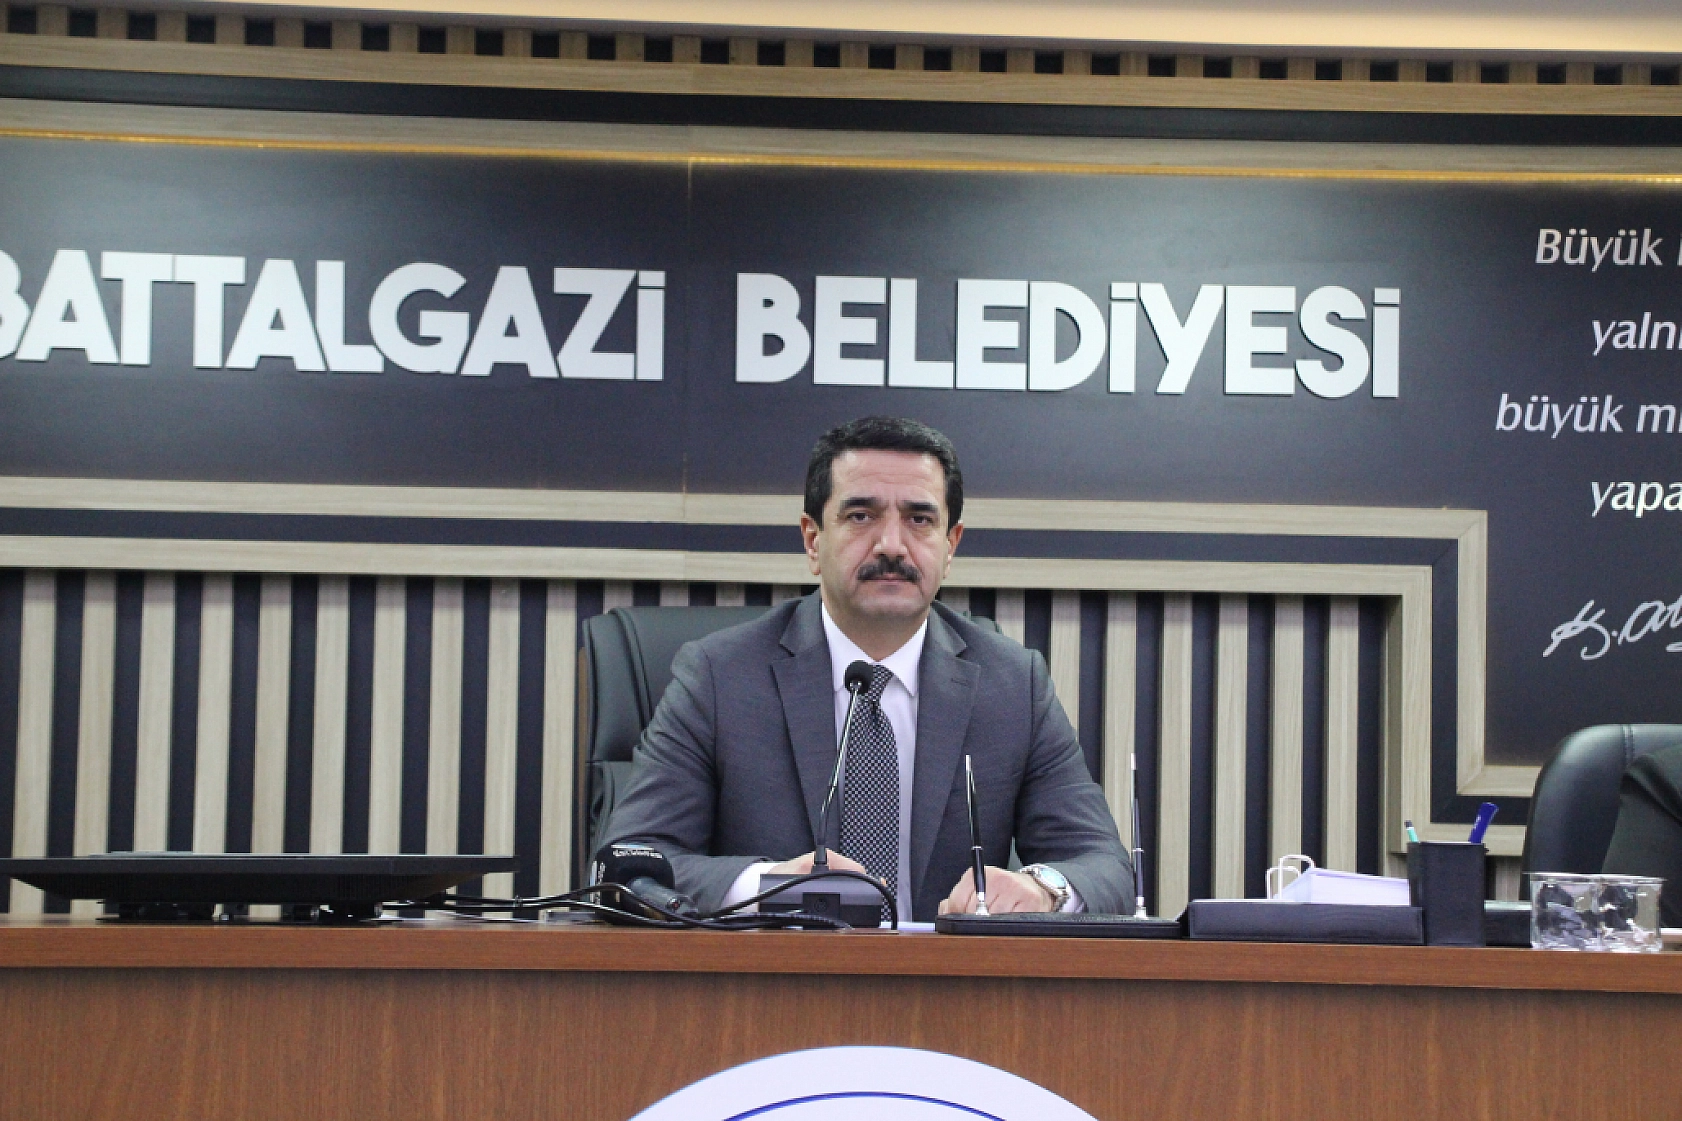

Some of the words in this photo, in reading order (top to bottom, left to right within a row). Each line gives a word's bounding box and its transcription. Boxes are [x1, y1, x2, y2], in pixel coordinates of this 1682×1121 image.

[1535, 228, 1663, 272] Büyük
[736, 272, 1401, 398] BELEDİYESİ
[1495, 392, 1624, 439] büyük
[1591, 482, 1682, 519] yapa
